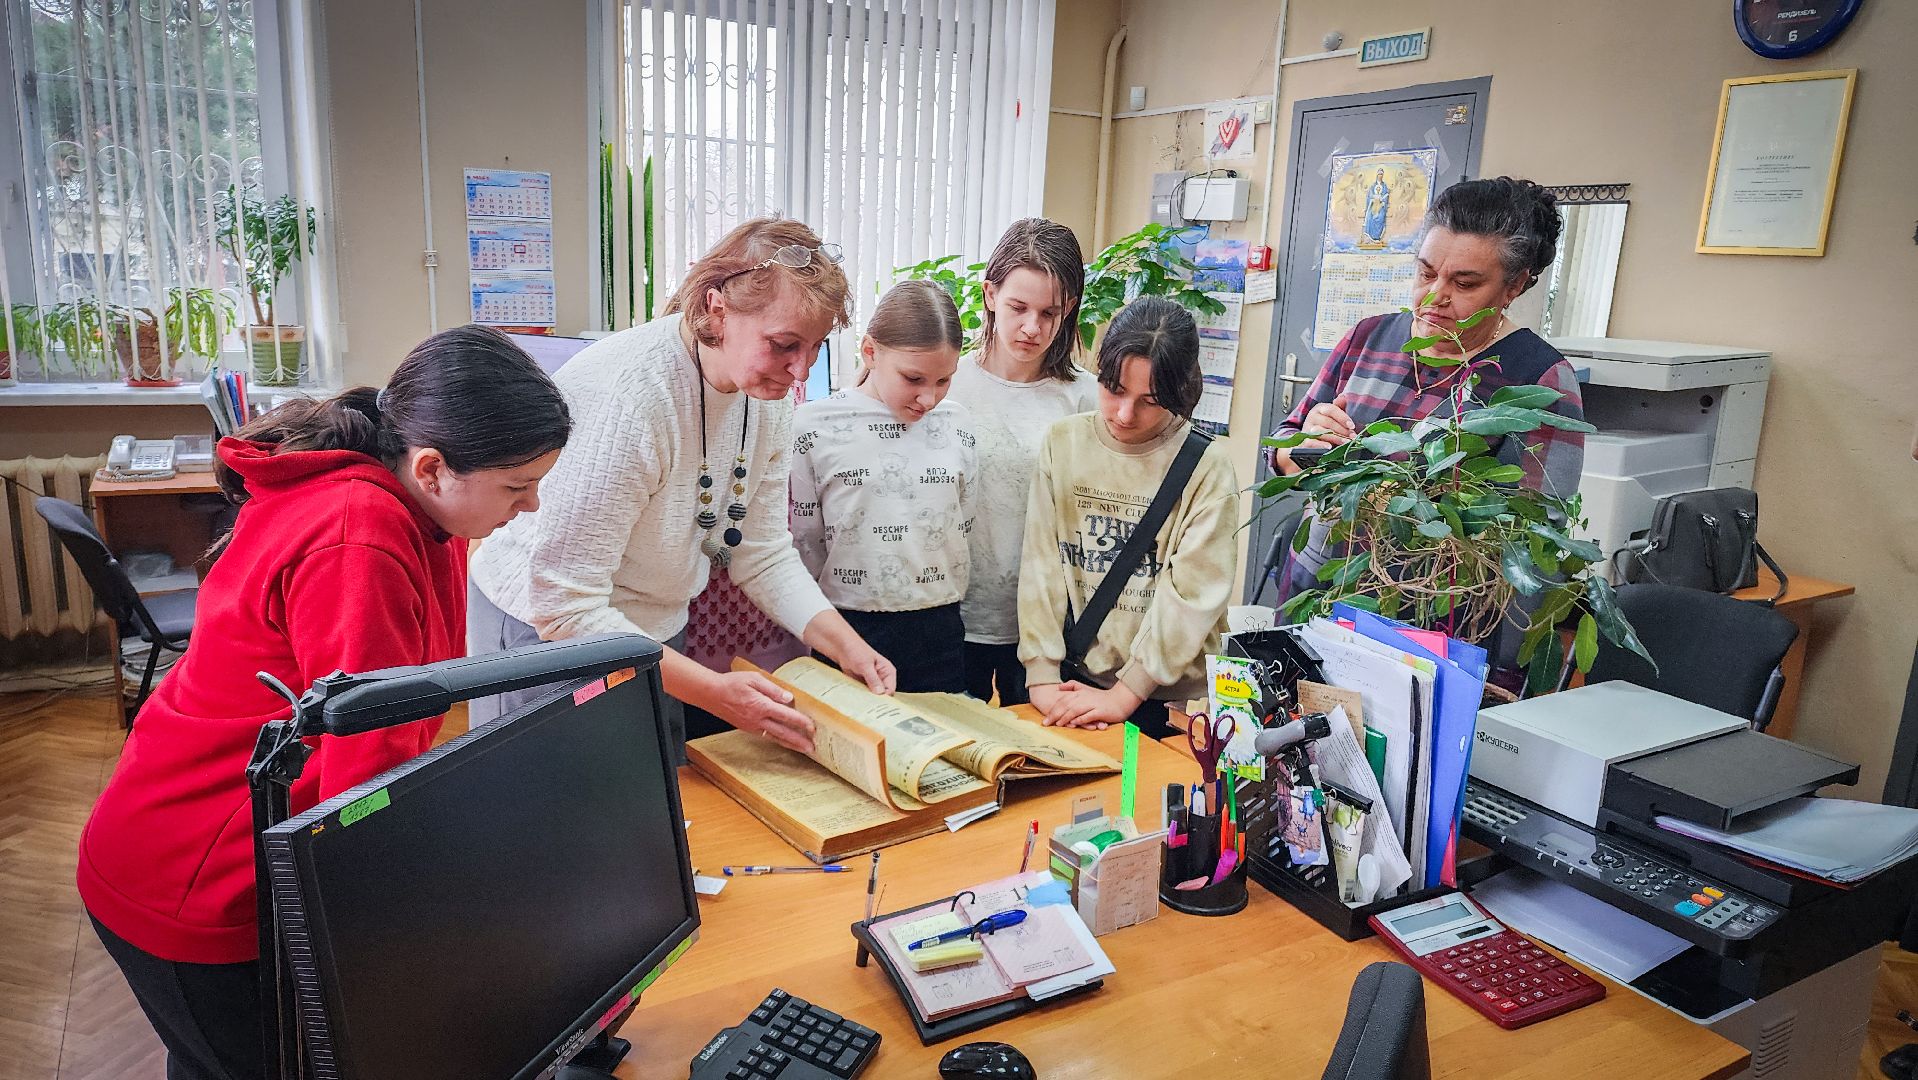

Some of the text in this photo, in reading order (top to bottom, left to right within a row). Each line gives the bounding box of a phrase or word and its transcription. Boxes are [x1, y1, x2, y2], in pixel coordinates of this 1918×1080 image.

[1788, 30, 1798, 42] 6
[1365, 35, 1422, 61] ВЫХОД
[868, 423, 907, 432] DESCHPE
[879, 432, 901, 440] CLUB
[926, 467, 947, 475] CLUB
[843, 478, 863, 486] CLUB
[1077, 499, 1144, 518] 123 NEW CLU
[872, 525, 909, 534] DESCHPE
[834, 568, 868, 578] DESCHPE
[841, 576, 862, 585] CLUB
[1224, 685, 1240, 693] АСТРА
[1485, 734, 1519, 754] KYOCERA
[554, 1028, 584, 1056] ViewSonic
